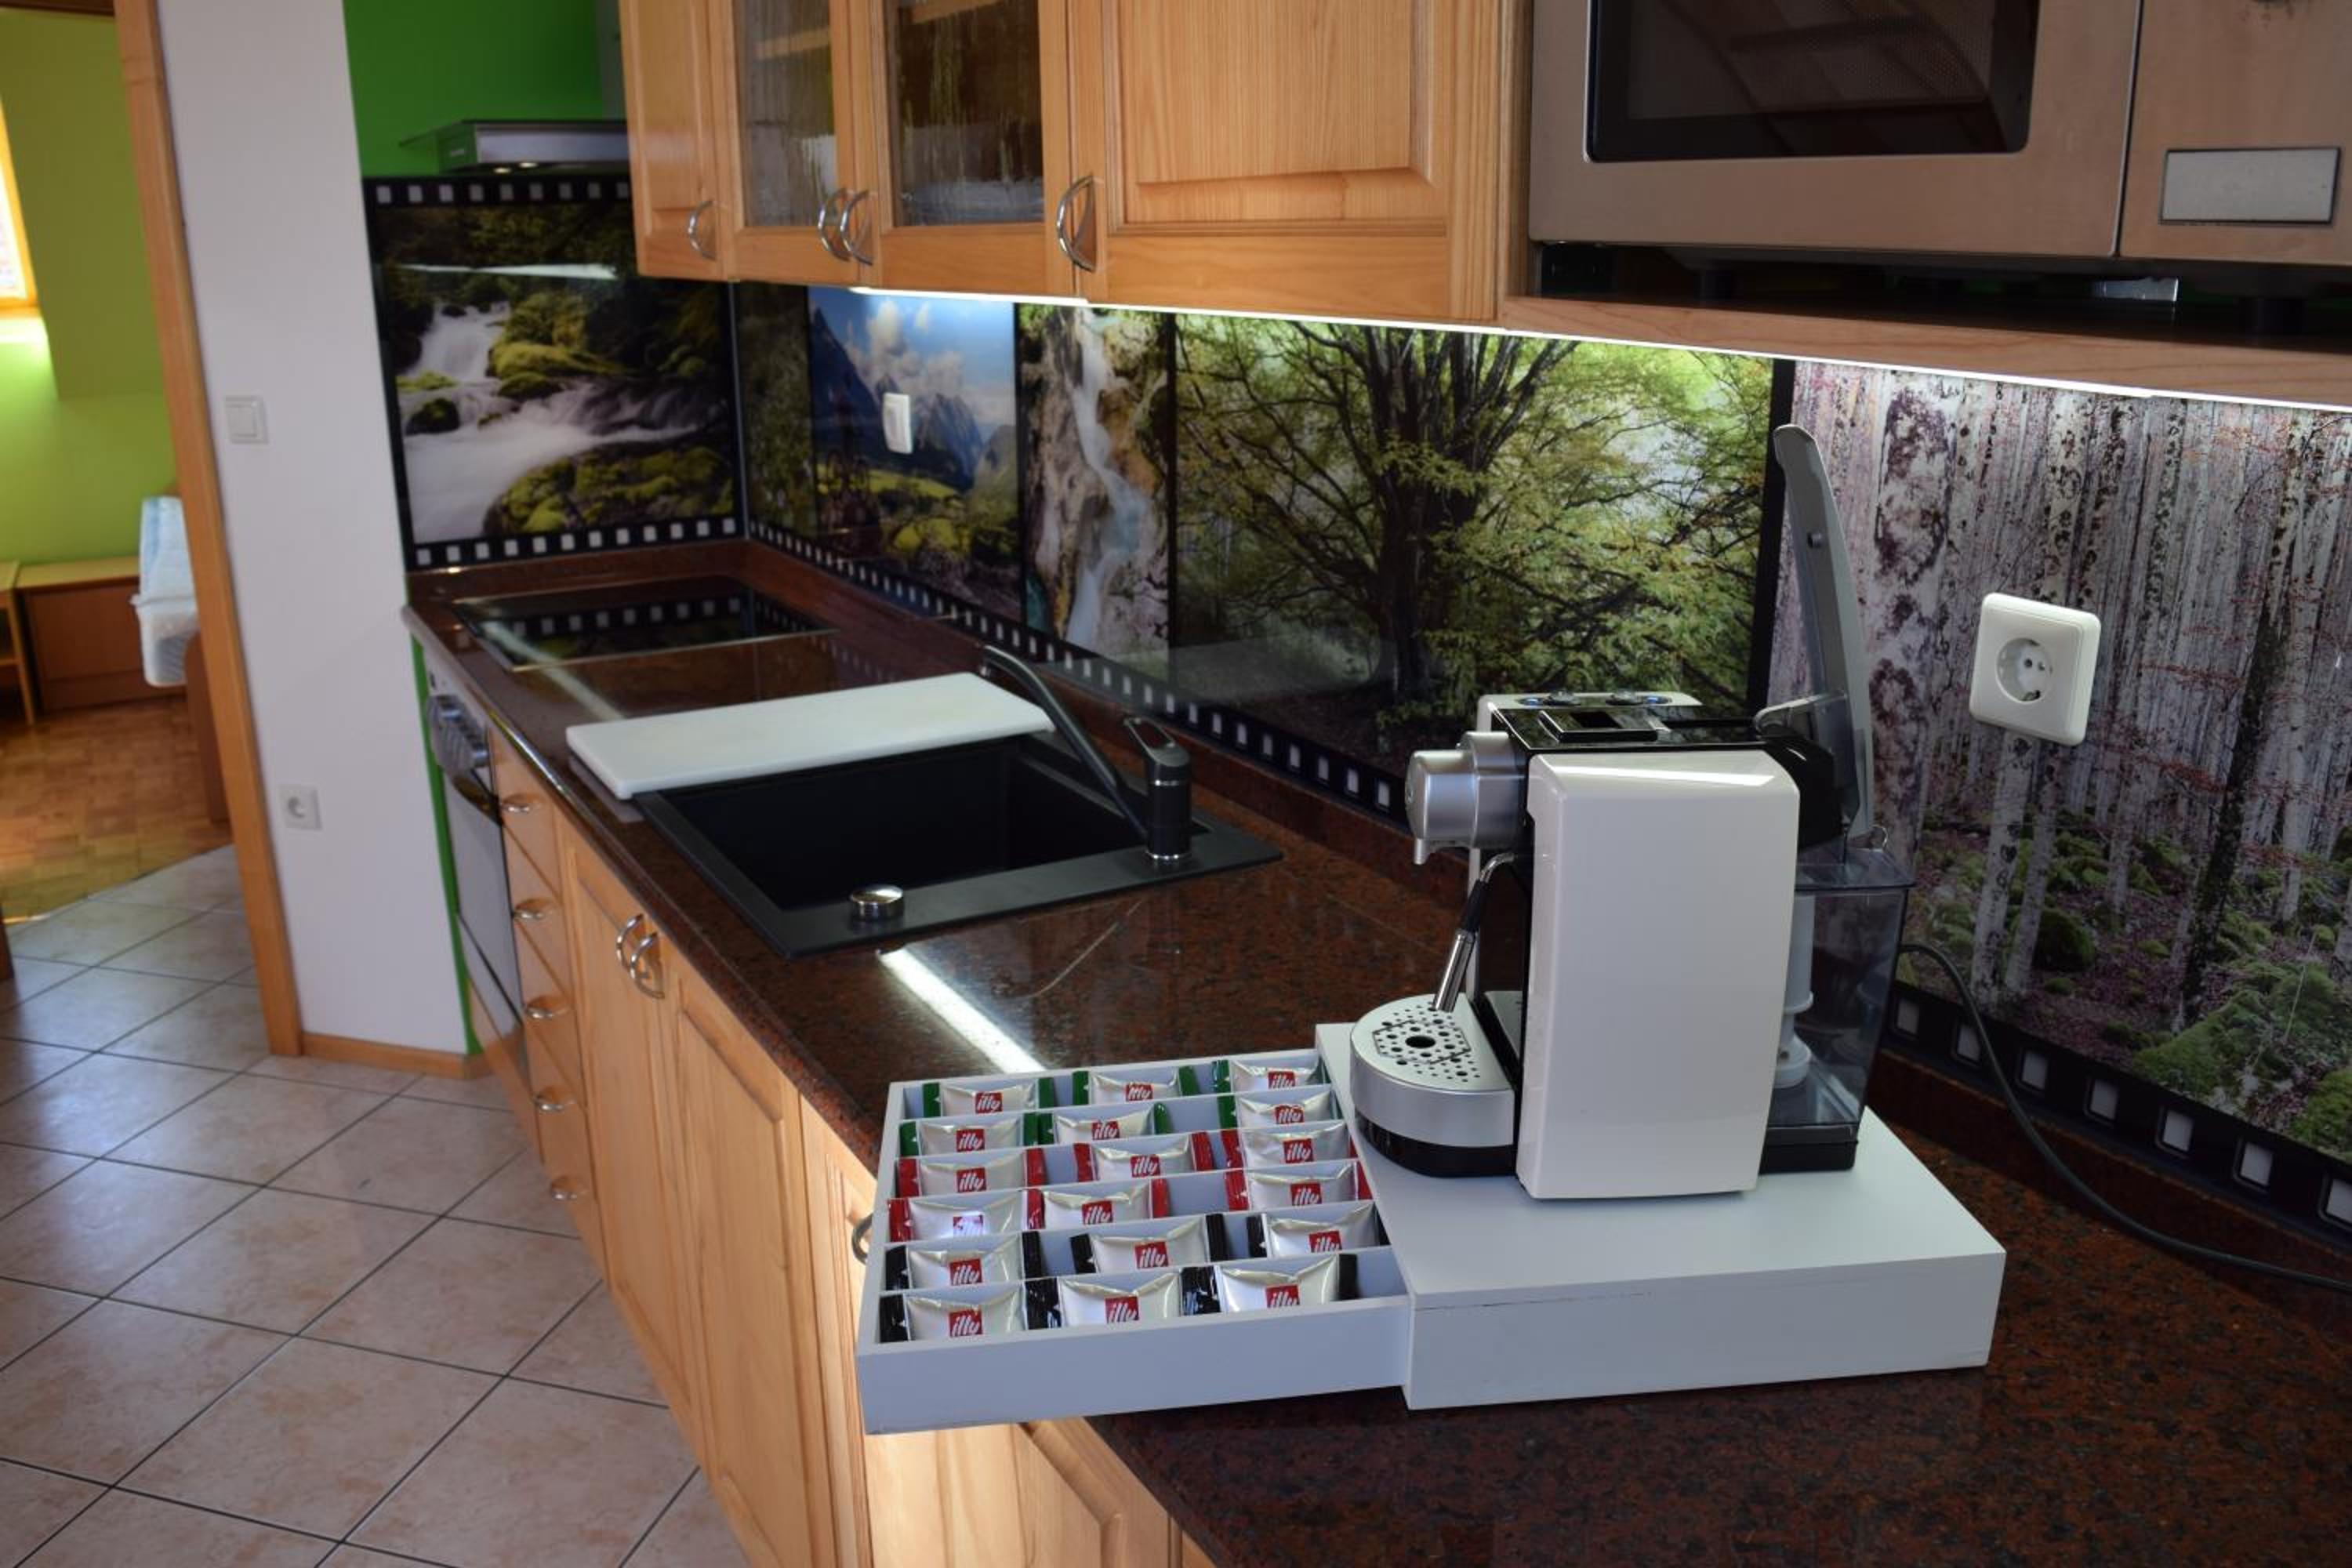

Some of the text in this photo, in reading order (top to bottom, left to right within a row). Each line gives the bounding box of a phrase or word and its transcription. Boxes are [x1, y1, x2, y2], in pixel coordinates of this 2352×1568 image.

[977, 1094, 1000, 1112] illy
[1094, 1122, 1117, 1138] illy
[959, 1133, 982, 1149] illy
[1287, 1143, 1311, 1160] illy
[1134, 1156, 1158, 1175] illy
[960, 1172, 984, 1190] illy
[1294, 1188, 1319, 1205] illy
[1085, 1206, 1110, 1223] illy
[1139, 1247, 1165, 1267] illy
[953, 1265, 980, 1284] illy
[1109, 1302, 1137, 1322] illy
[951, 1315, 980, 1336] illy
